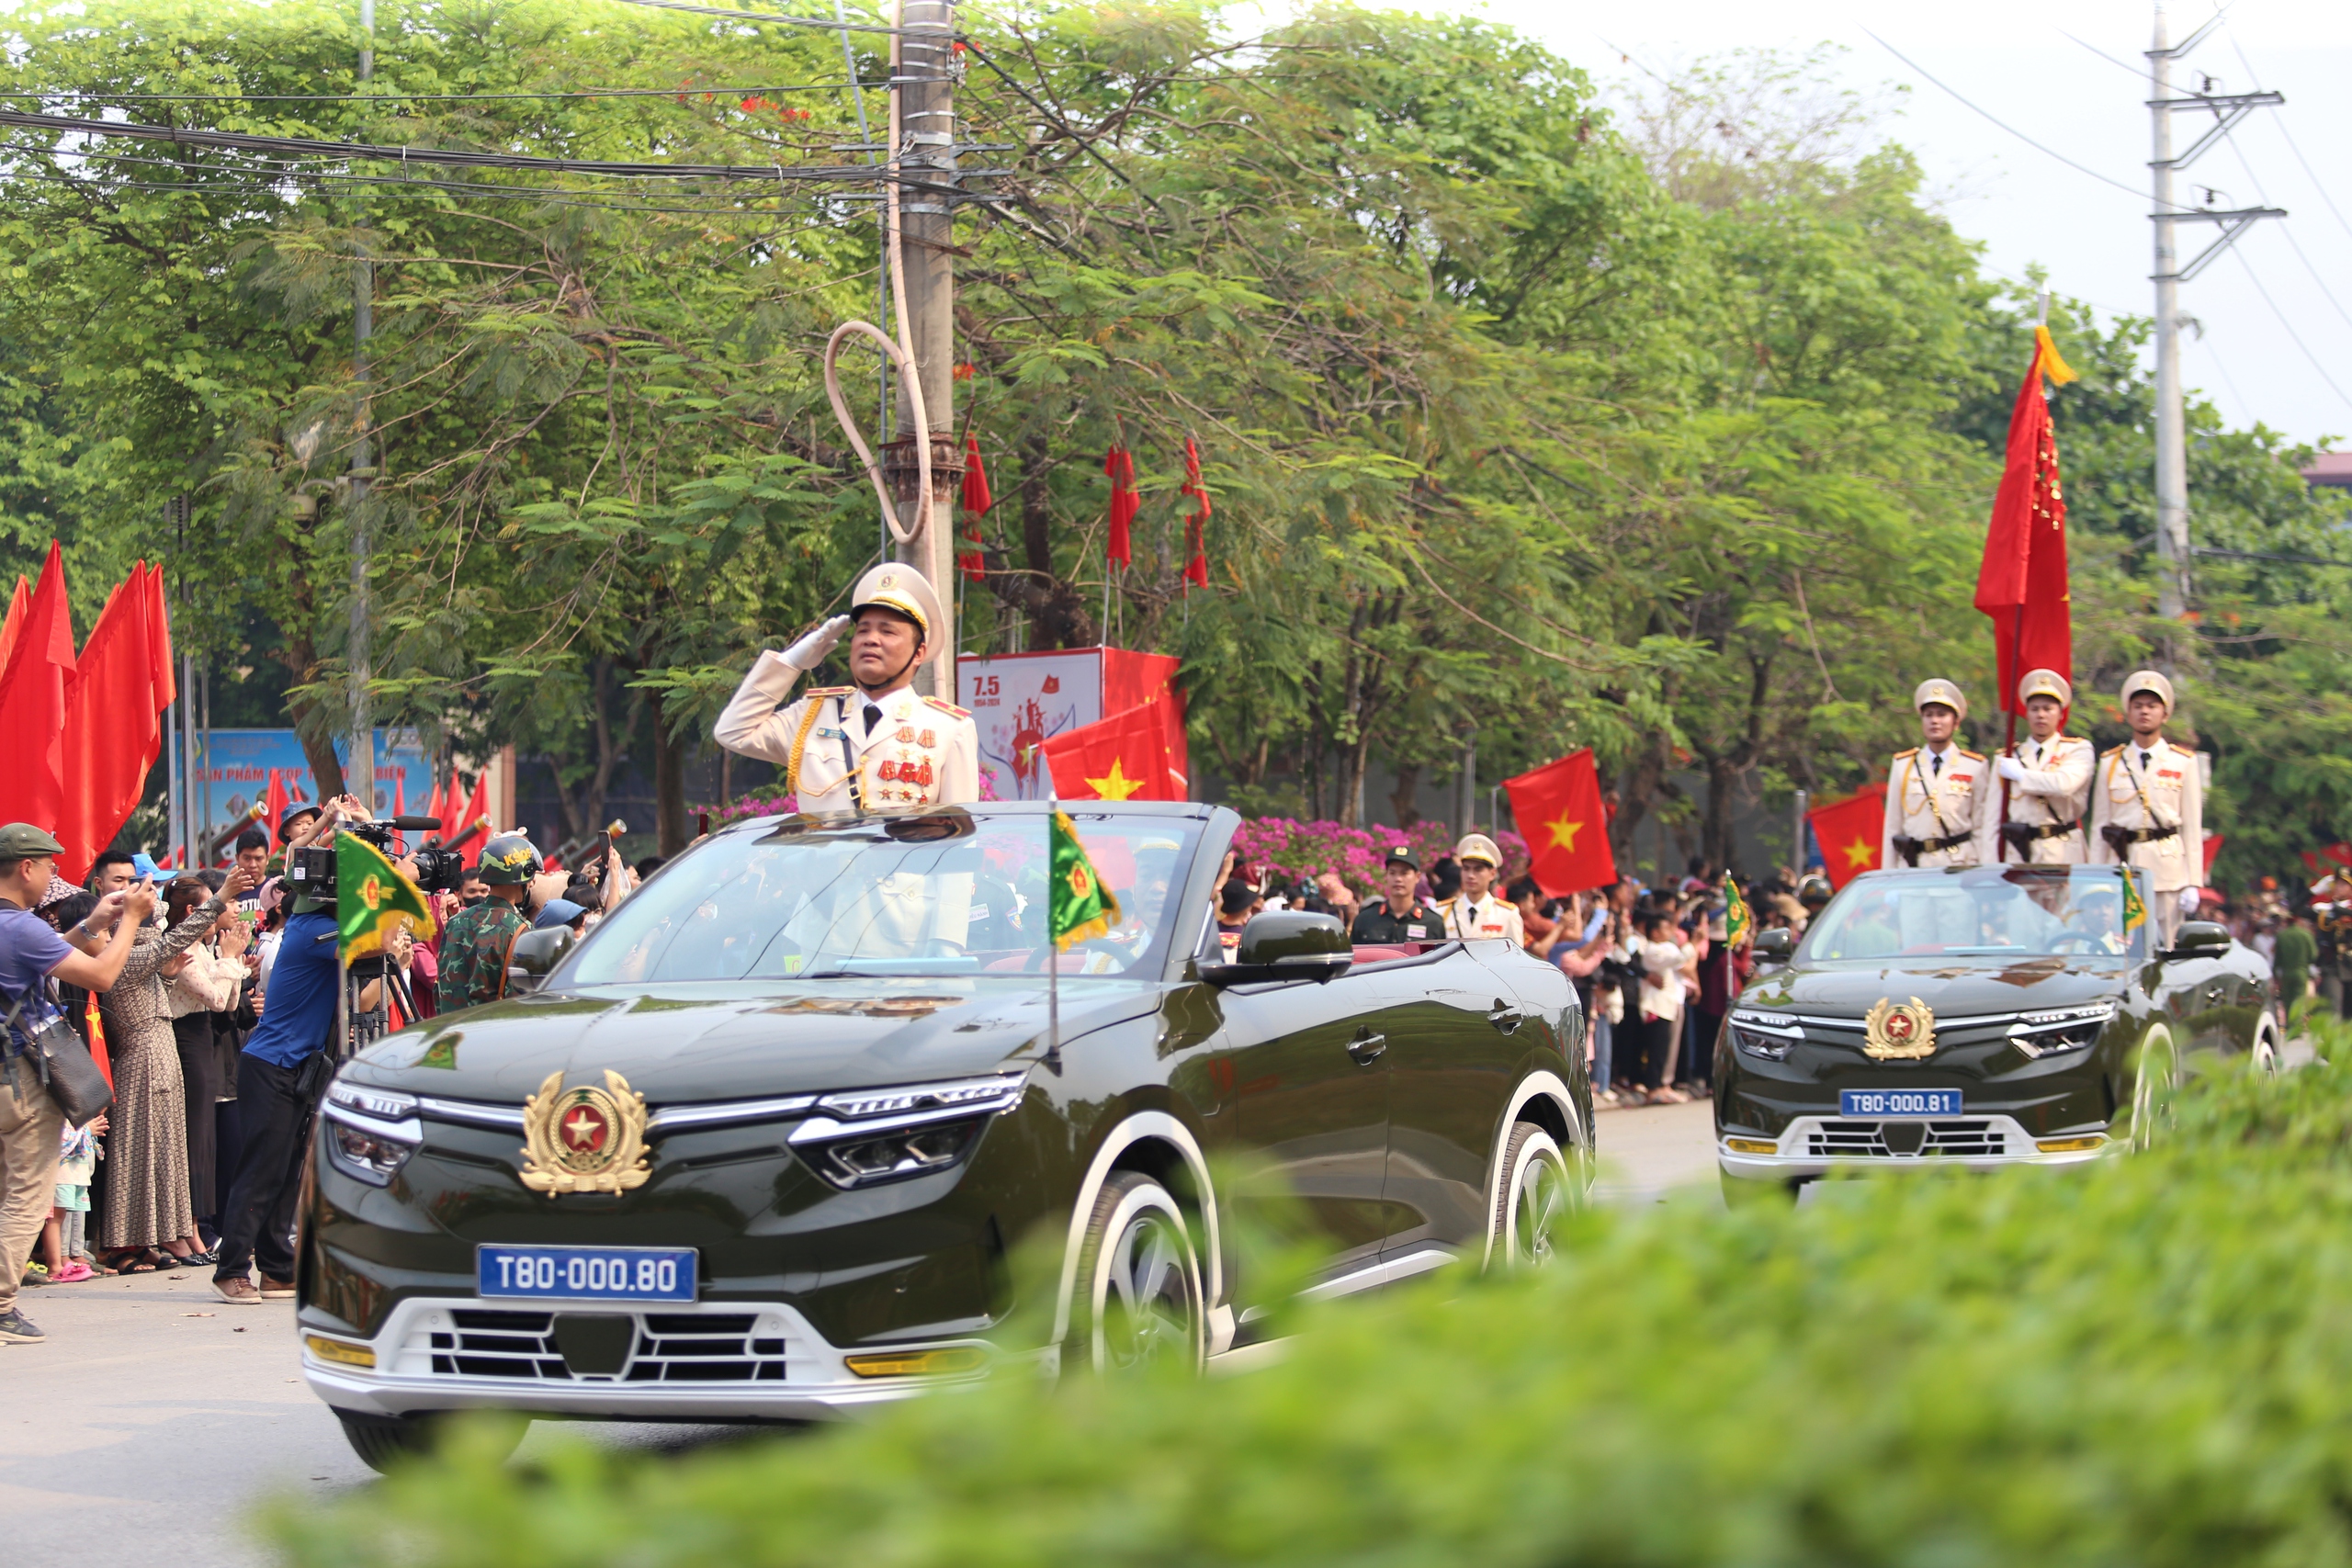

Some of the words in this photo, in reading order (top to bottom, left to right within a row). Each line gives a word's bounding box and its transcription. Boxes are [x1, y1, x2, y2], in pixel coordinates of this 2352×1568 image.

[973, 675, 1000, 696] 7.5
[1850, 1094, 1950, 1112] T80-000.81
[496, 1256, 676, 1292] T80-000.80
